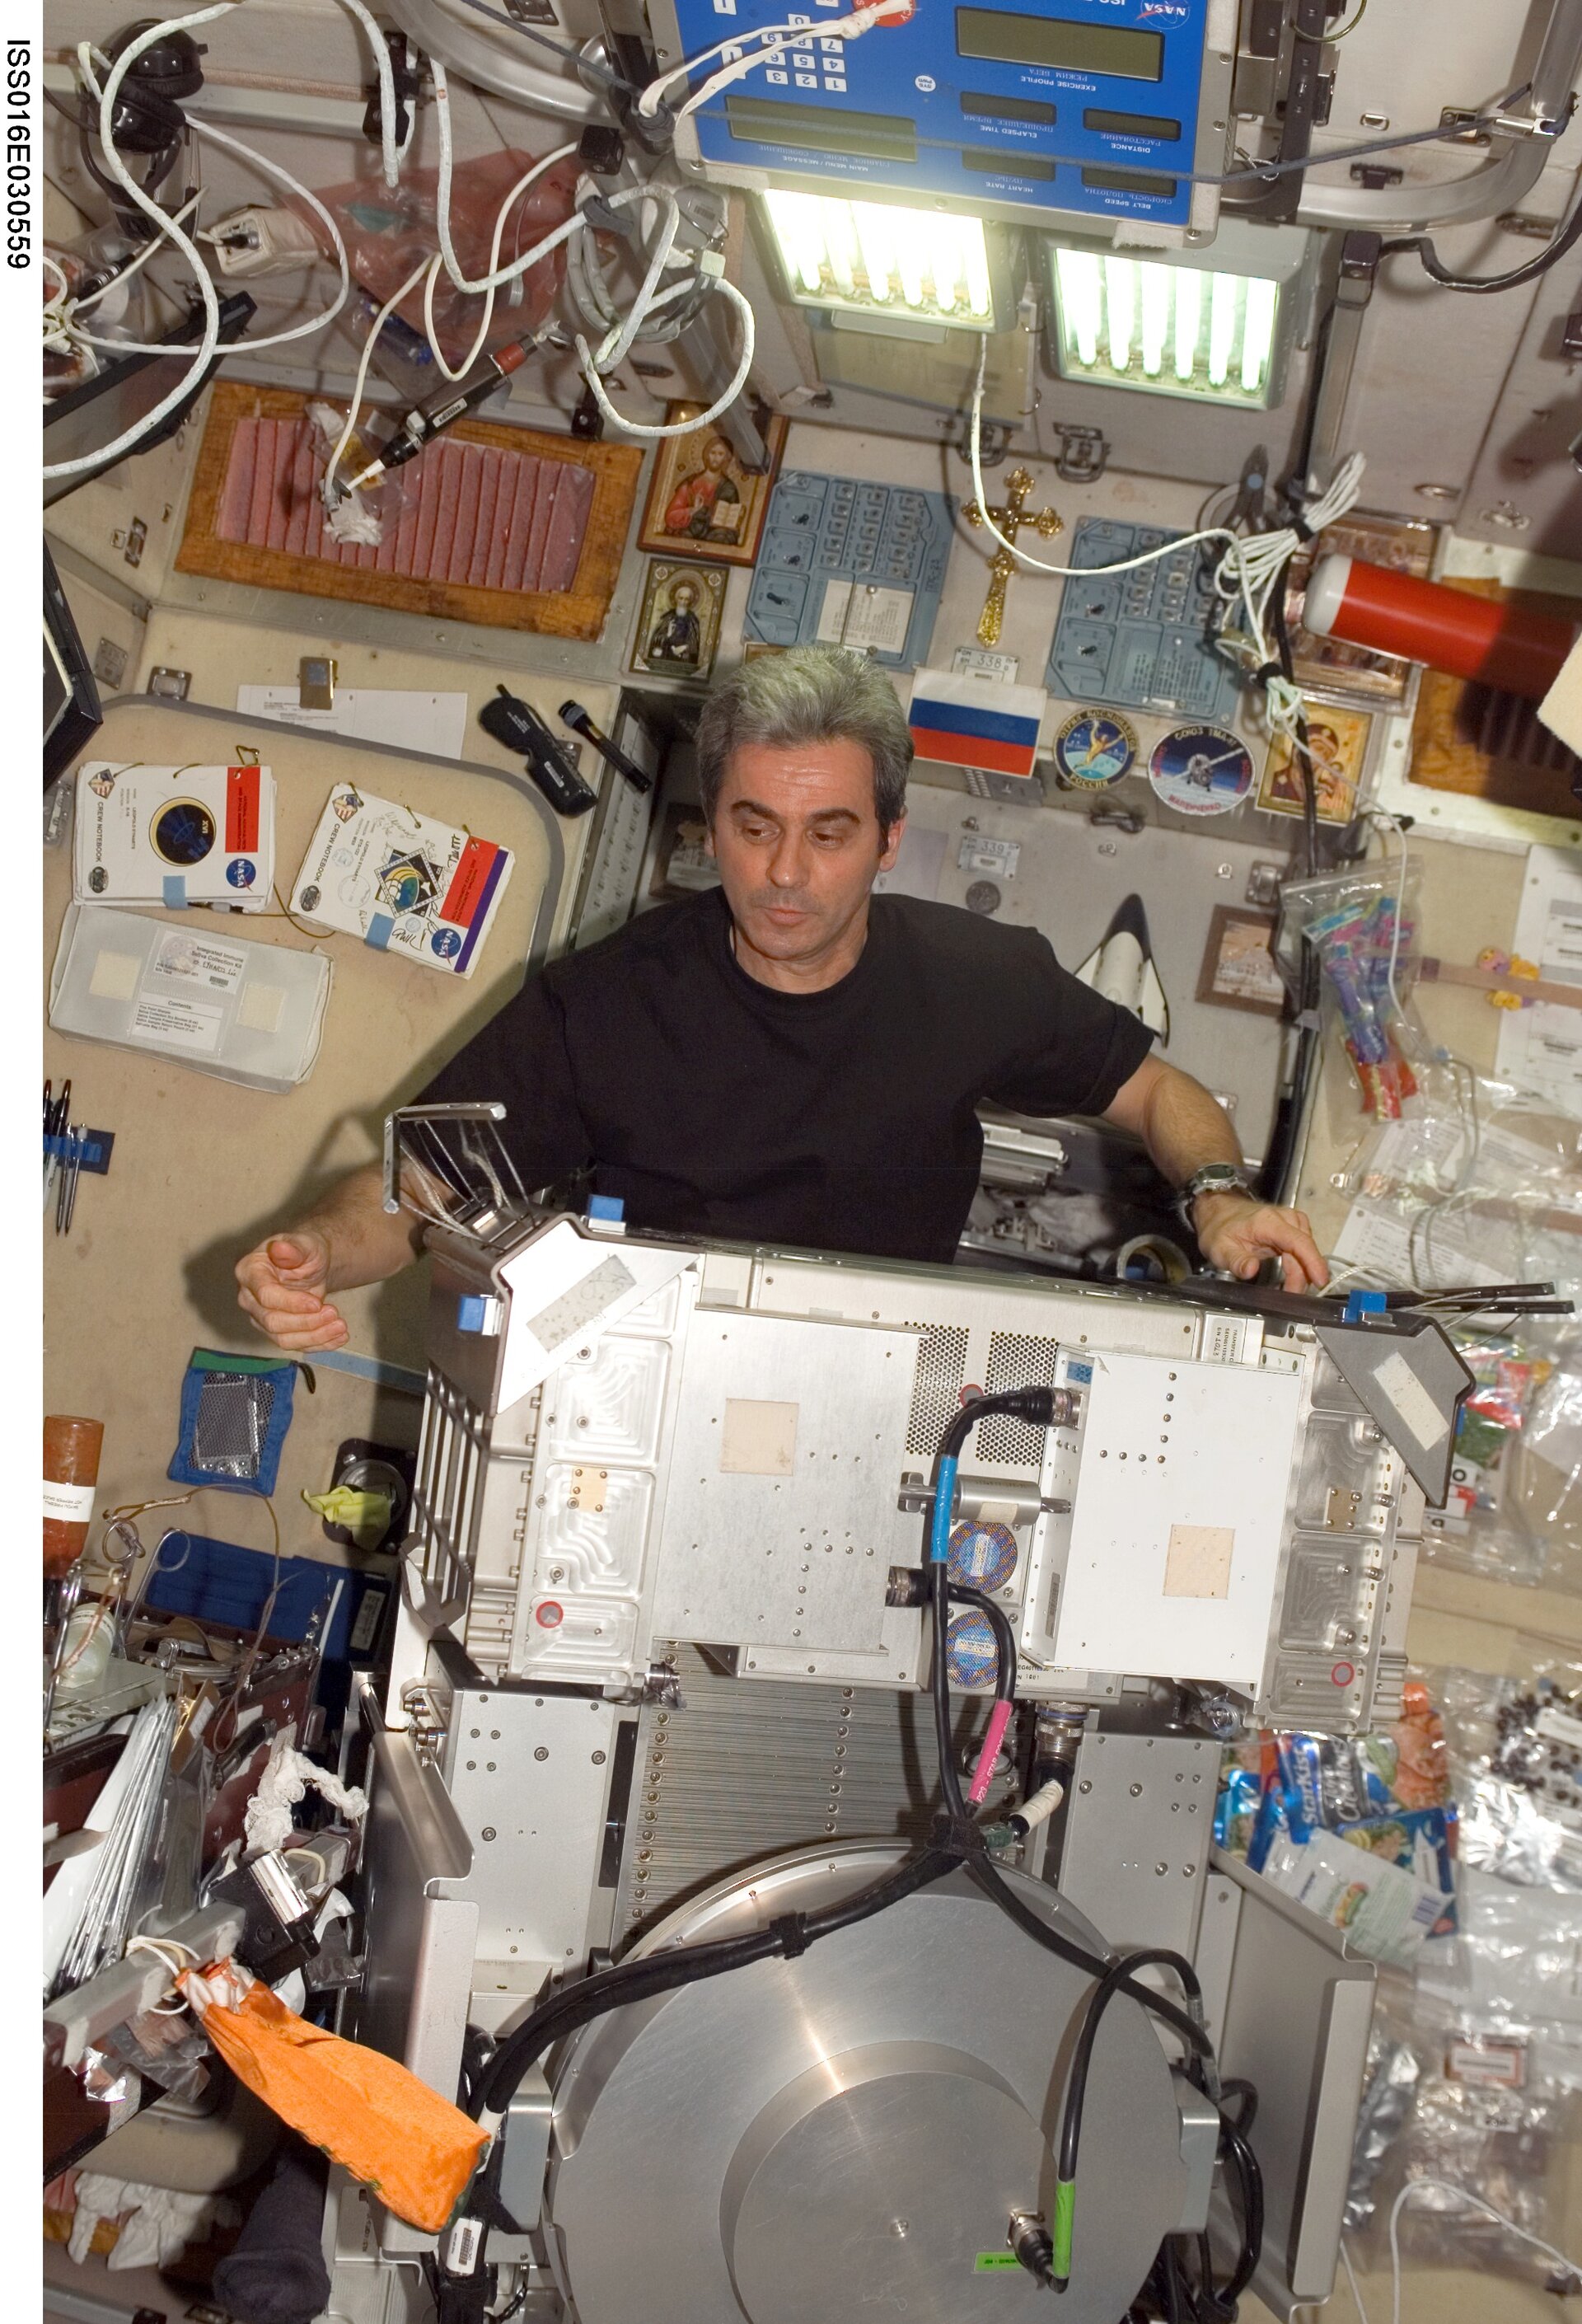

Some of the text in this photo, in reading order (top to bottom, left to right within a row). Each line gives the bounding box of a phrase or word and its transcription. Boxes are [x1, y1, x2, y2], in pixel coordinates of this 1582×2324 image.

[1143, 2, 1186, 16] NASA
[766, 32, 776, 42] 9
[827, 40, 836, 49] 7
[770, 52, 837, 68] 4 5 6
[771, 72, 840, 88] 1 2 3
[1020, 75, 1096, 91] EXERCISE PROFILE
[980, 124, 1037, 138] ELAPSED TIME
[1110, 142, 1150, 152] DISTANCE
[782, 155, 817, 164] MESSAGE
[985, 180, 1032, 192] HEART RATE
[1104, 197, 1150, 209] BELT SPEED
[976, 653, 1002, 668] 338
[314, 822, 340, 883] CREW NOTEBOOK
[981, 840, 1004, 855] 339
[438, 929, 453, 957] NASA
[1294, 1745, 1318, 1823] StarKist
